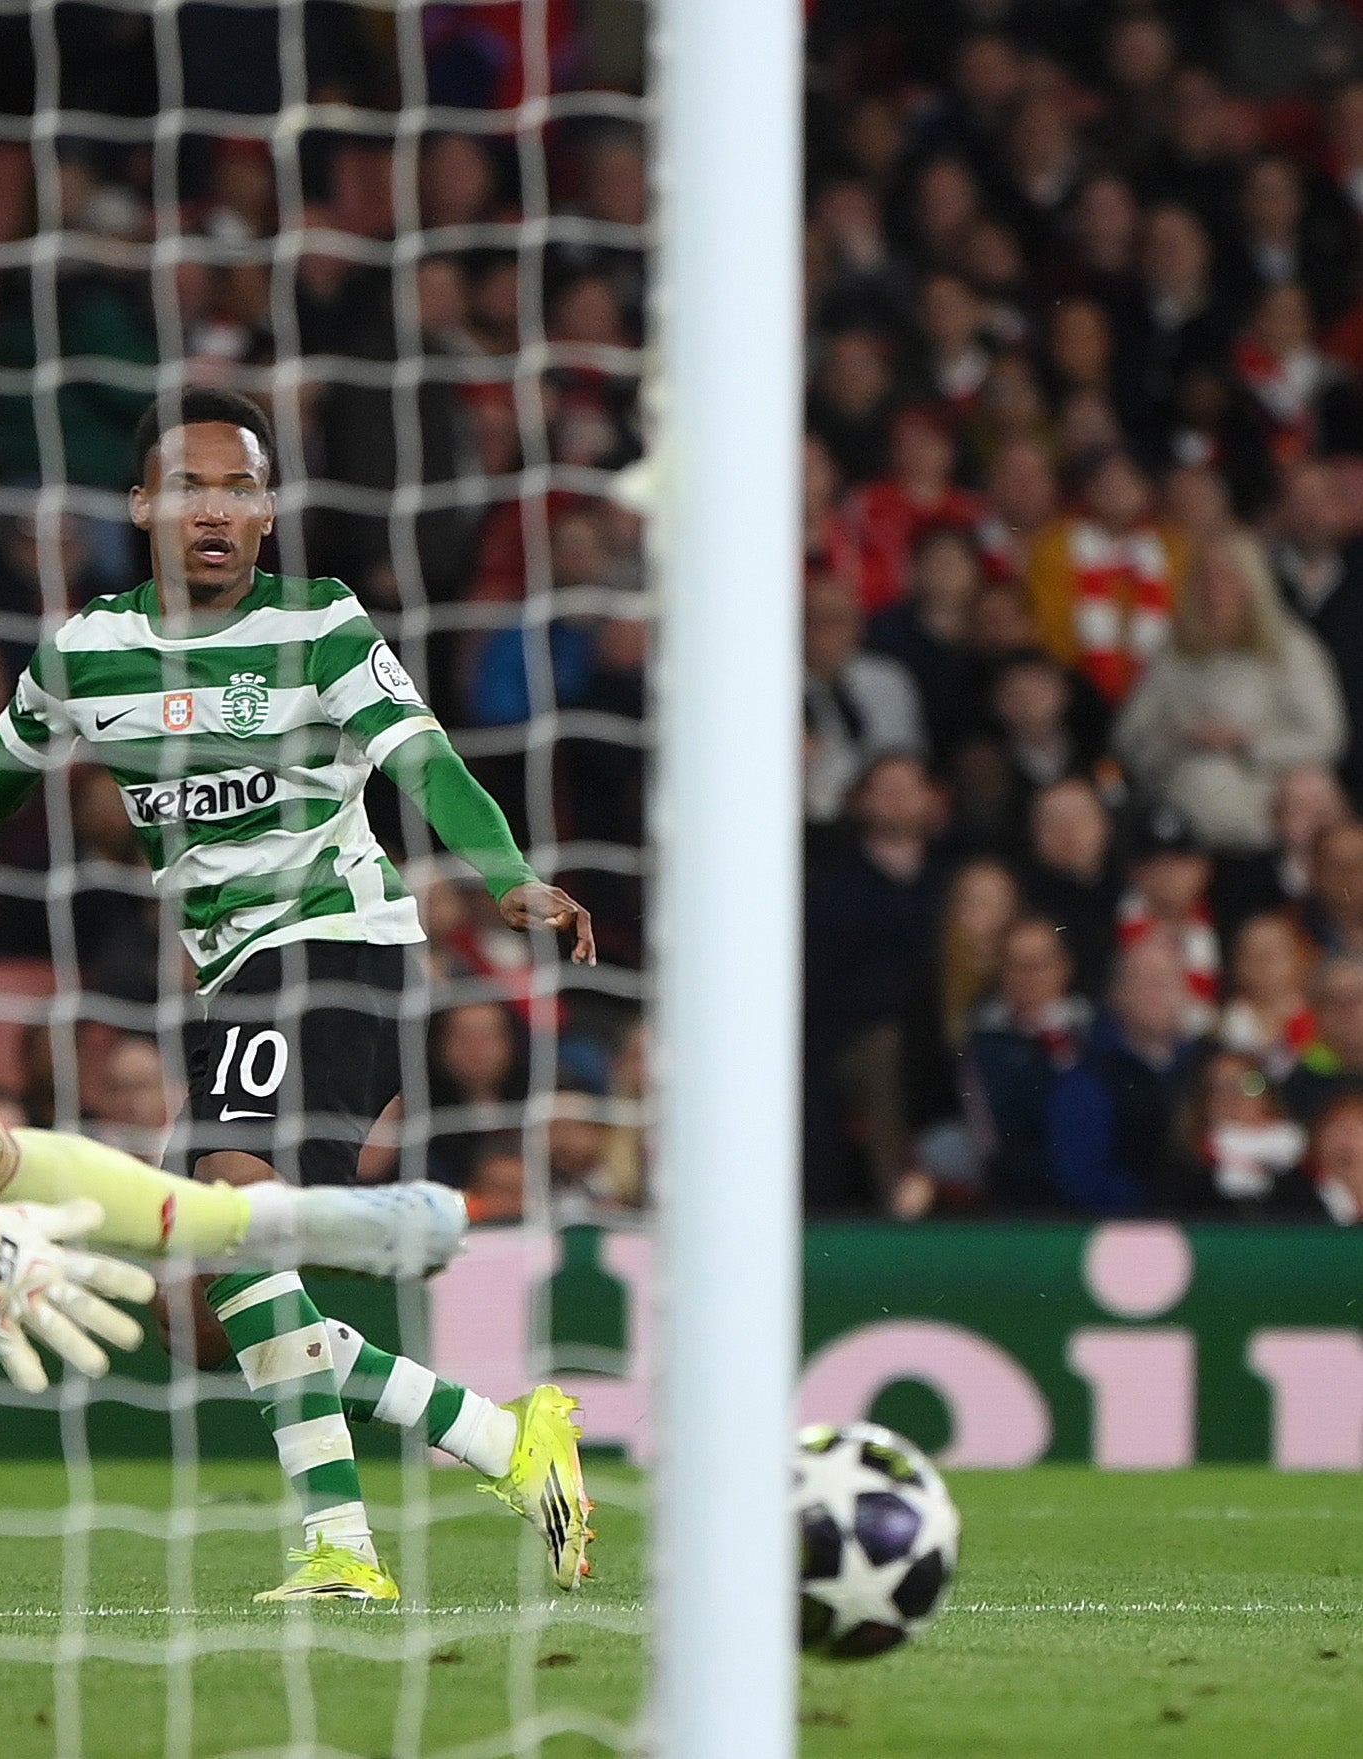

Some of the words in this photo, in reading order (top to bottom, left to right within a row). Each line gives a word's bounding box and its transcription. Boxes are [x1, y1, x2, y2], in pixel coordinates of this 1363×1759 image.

[229, 672, 267, 685] SCP
[128, 771, 277, 823] Betano
[209, 1025, 289, 1098] 10
